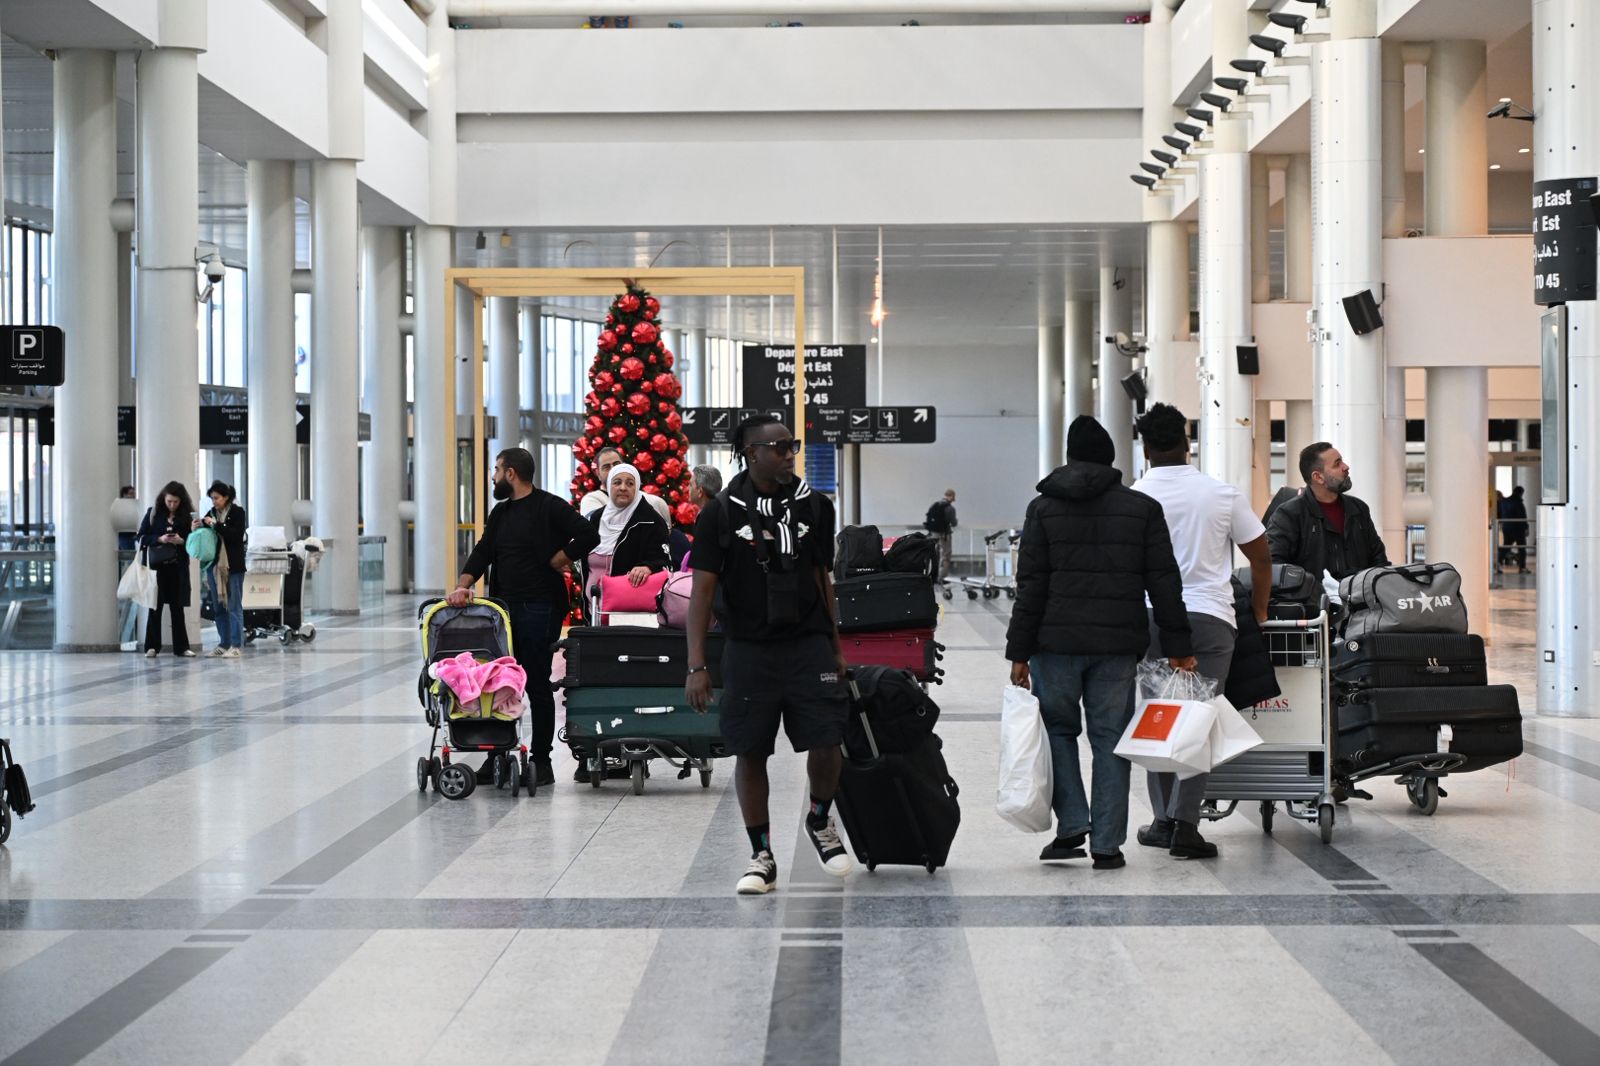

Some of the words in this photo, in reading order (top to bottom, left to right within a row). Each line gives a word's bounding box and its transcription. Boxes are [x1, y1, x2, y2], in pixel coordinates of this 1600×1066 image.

[1544, 189, 1572, 207] East
[1542, 215, 1560, 231] Est
[1537, 240, 1559, 262] ذهاب
[1546, 273, 1560, 288] 45
[20, 334, 37, 355] P
[820, 346, 843, 357] East
[777, 362, 813, 374] Déprt
[815, 362, 832, 372] Est
[808, 375, 834, 389] ذهاب
[783, 394, 790, 405] 1
[813, 393, 829, 404] 45
